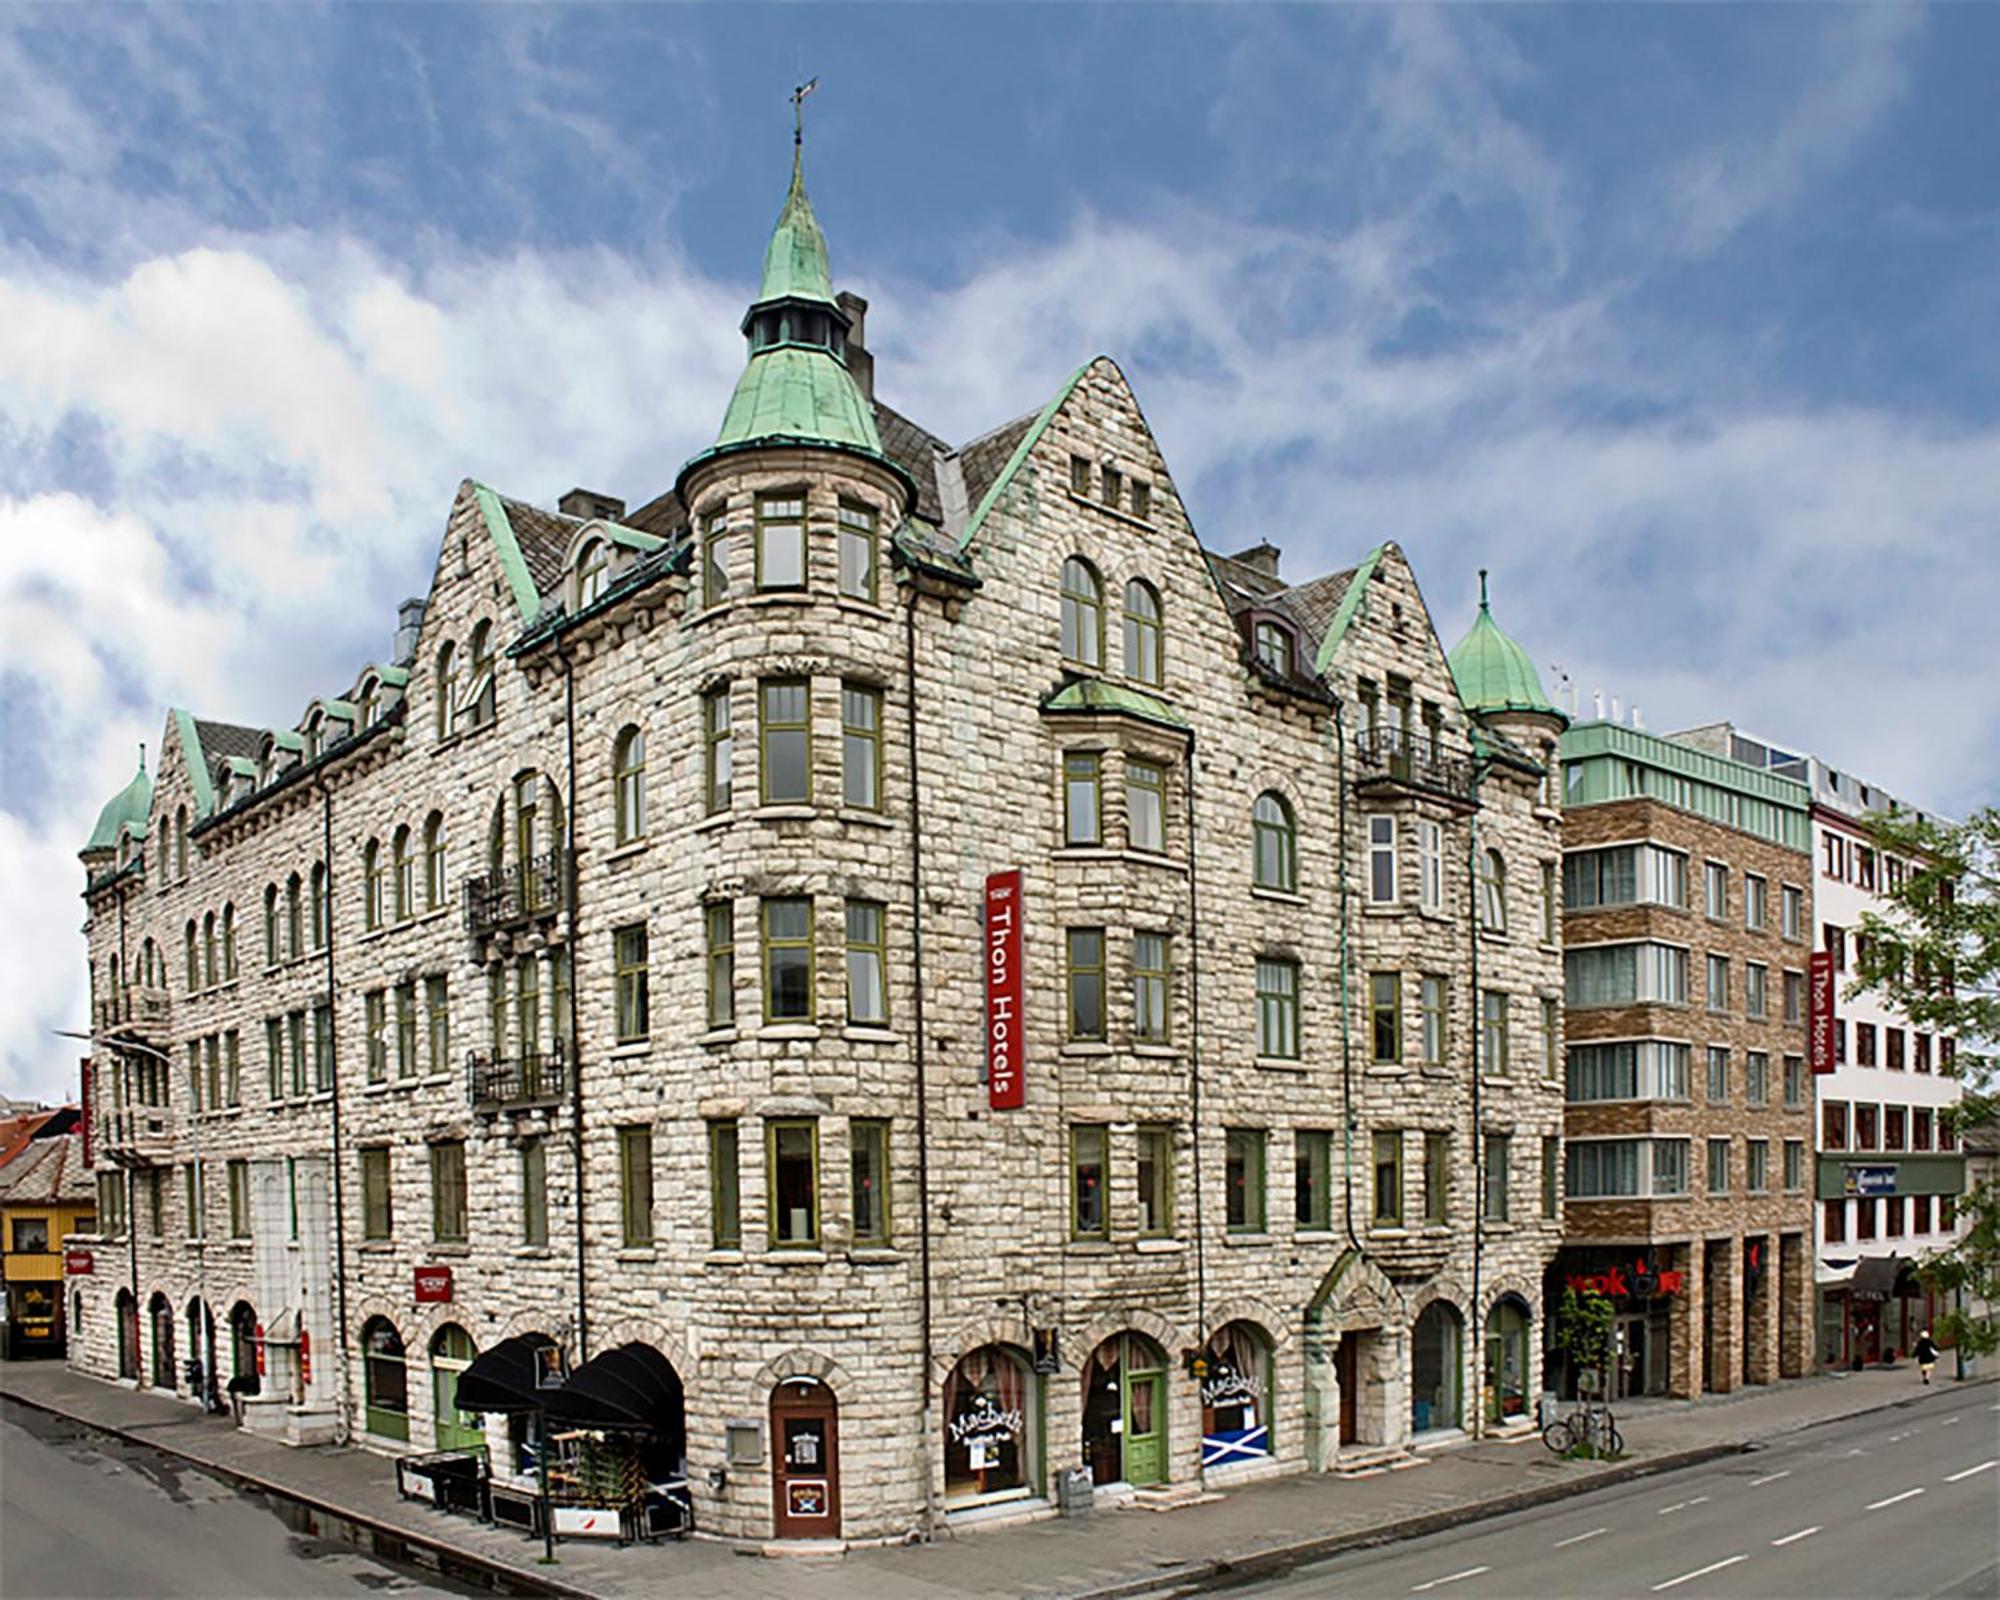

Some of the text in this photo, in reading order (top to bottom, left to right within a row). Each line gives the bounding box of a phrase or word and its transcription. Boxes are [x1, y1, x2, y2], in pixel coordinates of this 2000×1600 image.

[991, 905, 1012, 985] Thon
[993, 996, 1014, 1094] Hotels
[1202, 1367, 1261, 1405] Macbeth
[948, 1402, 1023, 1442] Macbeth
